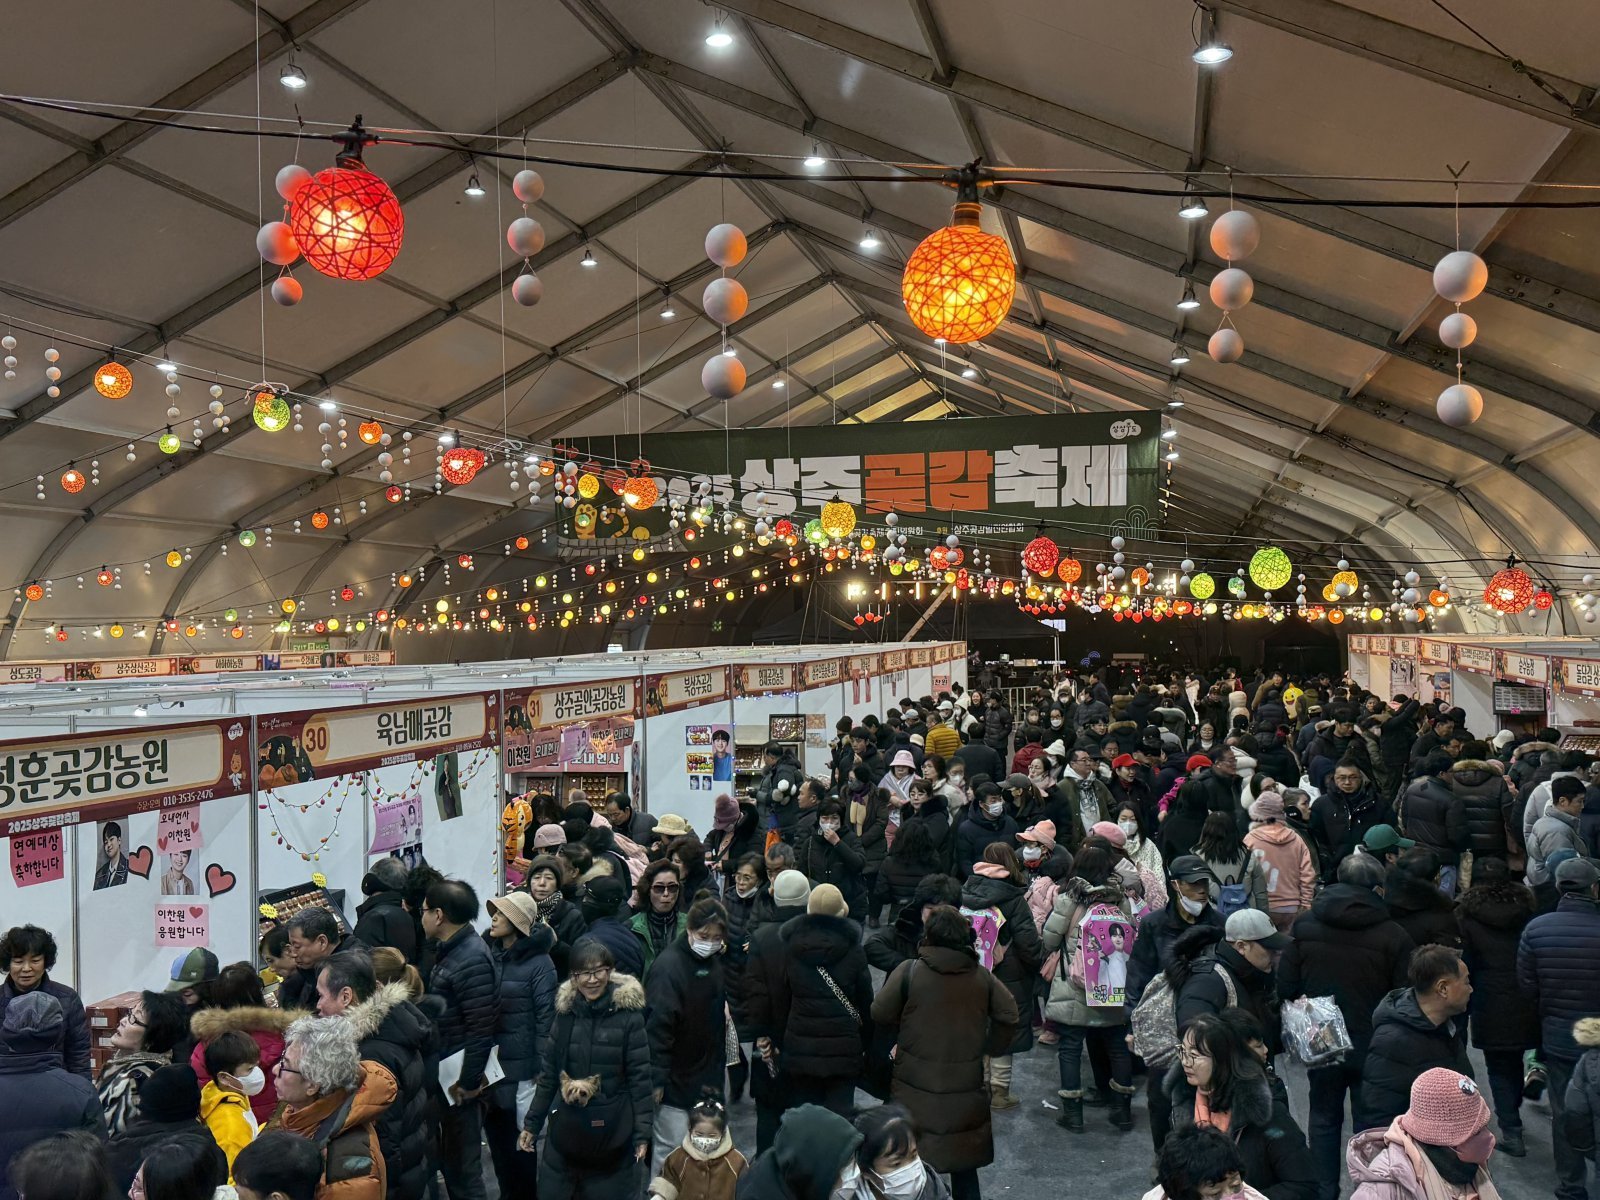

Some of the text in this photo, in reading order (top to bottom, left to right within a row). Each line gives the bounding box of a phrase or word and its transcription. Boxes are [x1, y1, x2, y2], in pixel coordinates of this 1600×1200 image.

[741, 444, 1128, 518] 상주곶감축제
[660, 683, 668, 698] 32
[684, 672, 712, 697] 북상주곶감
[529, 699, 540, 718] 31
[376, 705, 452, 747] 육남매곶감
[305, 726, 327, 753] 30
[507, 744, 531, 767] 이찬원
[163, 789, 214, 807] 010-3535-2476
[160, 810, 190, 825] 오내언사
[168, 828, 192, 843] 이찬원
[13, 833, 60, 858] 연예대상
[15, 861, 60, 881] 축하합니다
[157, 909, 185, 922] 이찬원
[158, 926, 205, 940] 응원합니다
